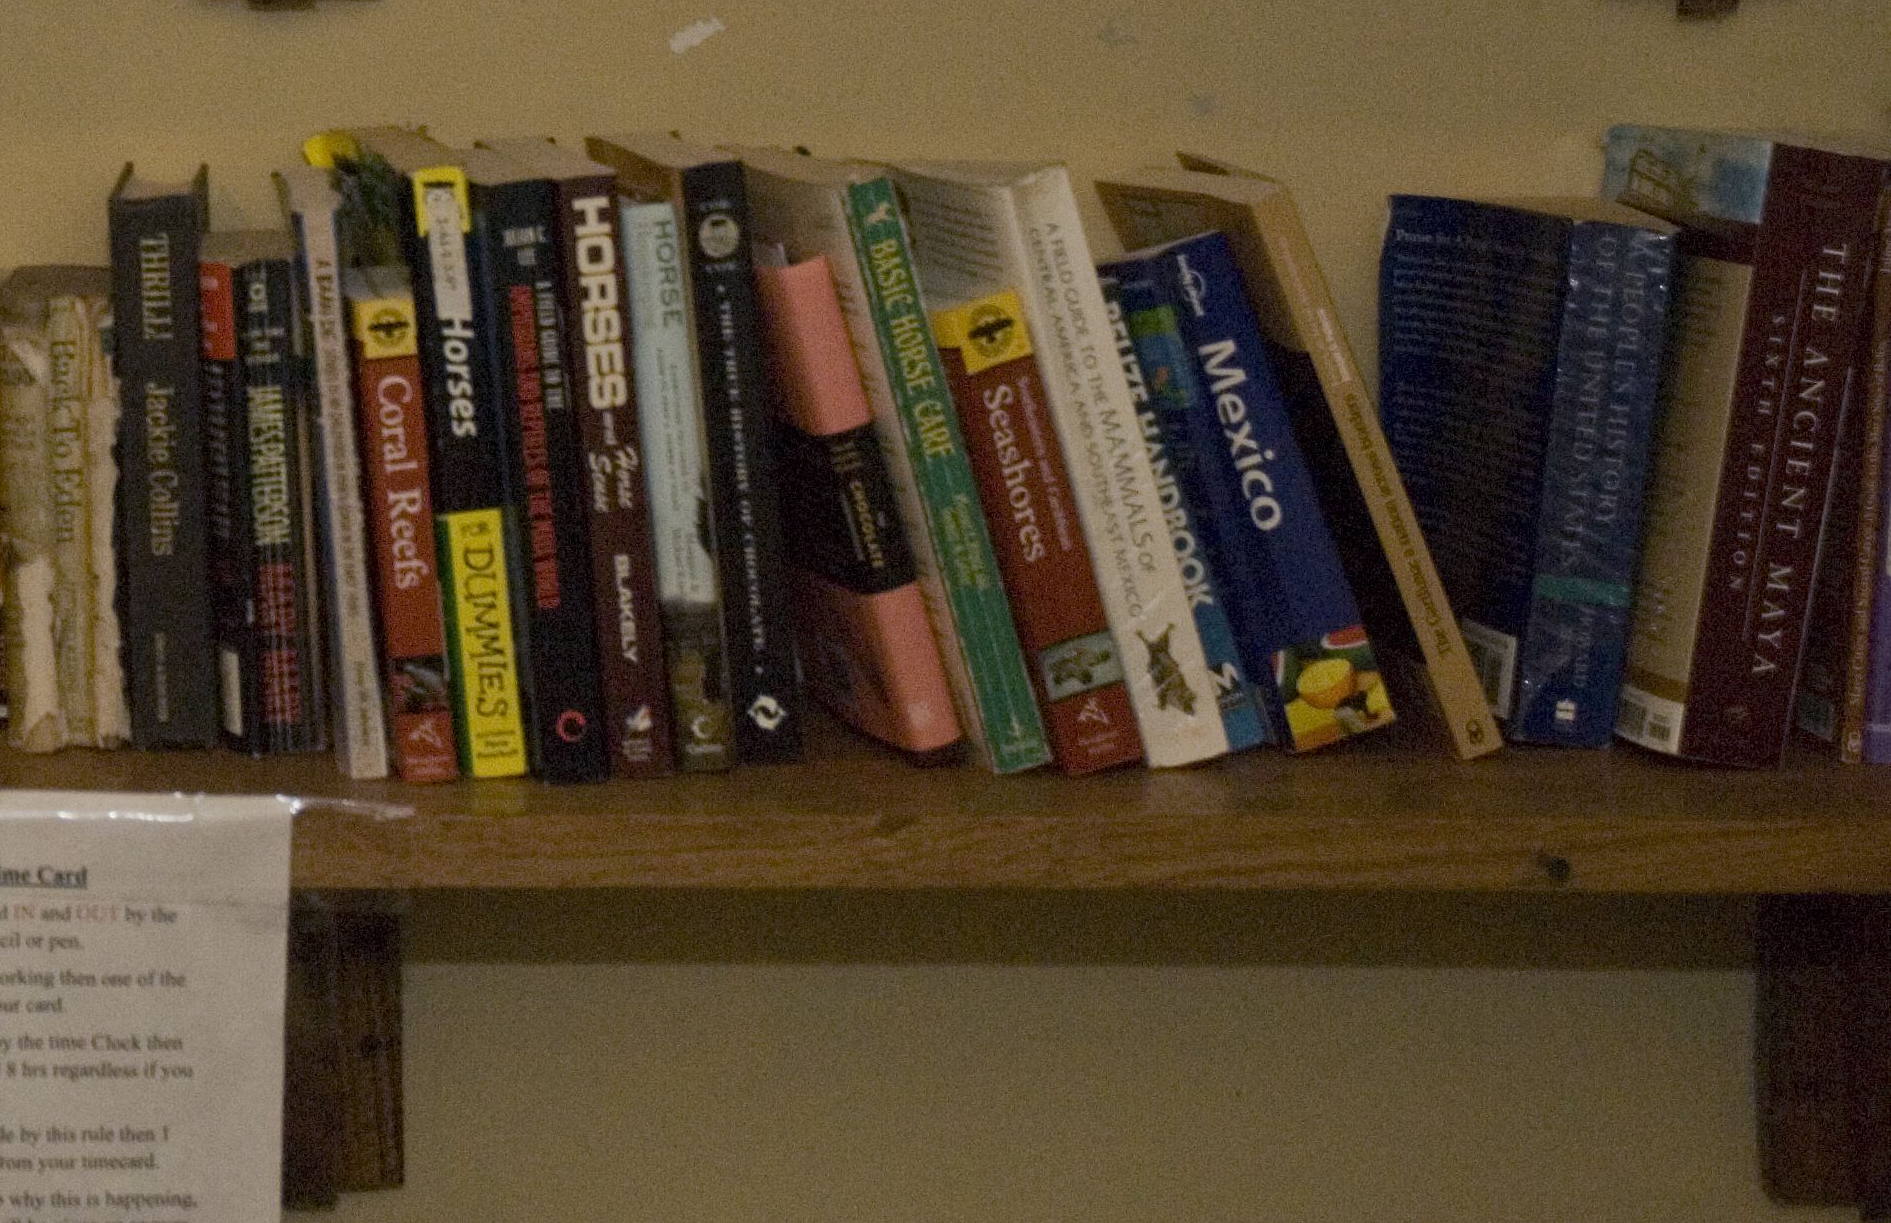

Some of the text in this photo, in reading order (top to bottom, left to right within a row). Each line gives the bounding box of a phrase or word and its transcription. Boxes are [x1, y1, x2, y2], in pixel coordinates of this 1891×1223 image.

[139, 231, 173, 341] THRILL!
[570, 194, 627, 411] HORSES
[867, 238, 957, 463] BASIC HORSE CARE
[48, 339, 81, 546] Back To Eden
[245, 384, 284, 445] JAMES
[440, 317, 478, 437] Horses
[1198, 339, 1282, 531] Mexico
[1727, 312, 1788, 593] SIXTH EDITION
[1749, 243, 1850, 678] THE ANCIENT MAYA
[144, 379, 181, 557] Jackie Collins
[250, 441, 291, 547] PATTERSON
[375, 375, 430, 590] Coral Reefs
[983, 383, 1048, 565] Seashores
[460, 543, 508, 720] DUMMIES
[613, 553, 640, 664] BLAKELY
[25, 935, 44, 949] or
[36, 864, 88, 889] Card
[40, 905, 71, 922] and
[124, 906, 145, 927] by
[151, 906, 178, 924] the
